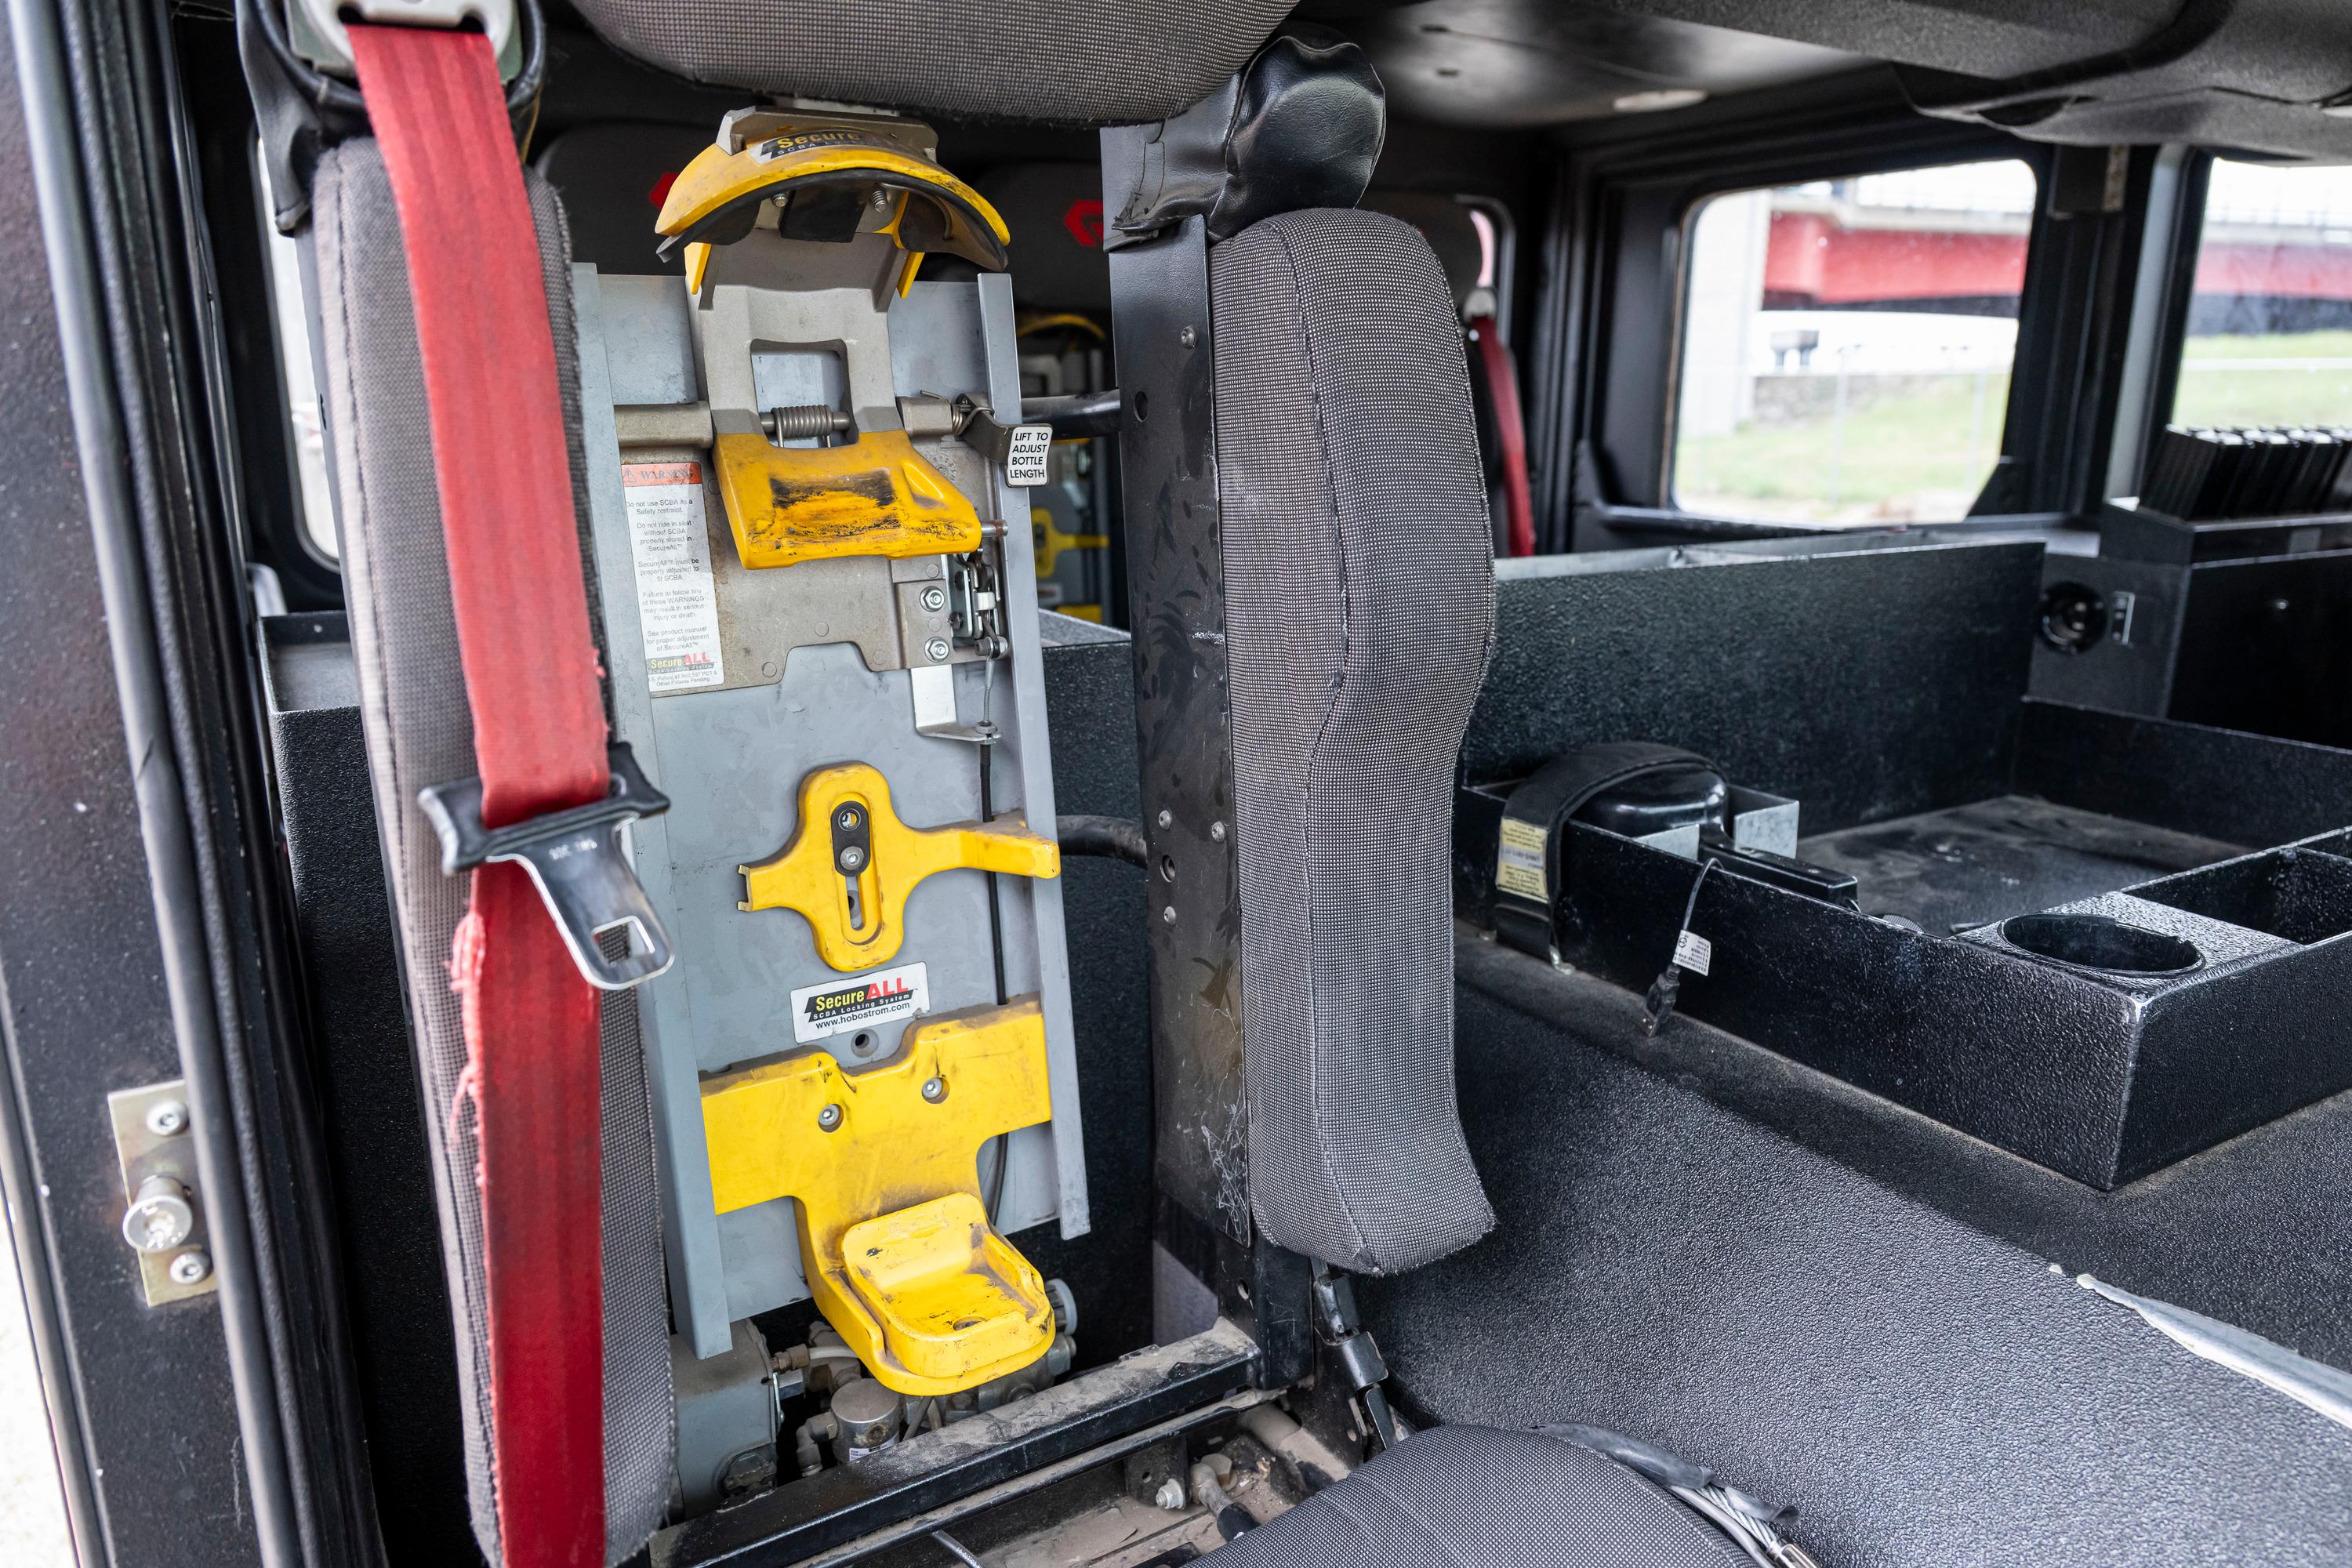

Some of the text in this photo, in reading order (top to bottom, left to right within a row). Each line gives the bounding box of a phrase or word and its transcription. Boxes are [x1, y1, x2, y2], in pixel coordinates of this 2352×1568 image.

[641, 468, 693, 479] WARNING
[1011, 470, 1044, 478] LENGTH
[813, 994, 909, 1019] SCBA Locking System
[816, 1003, 909, 1029] www.hobostrom.com
